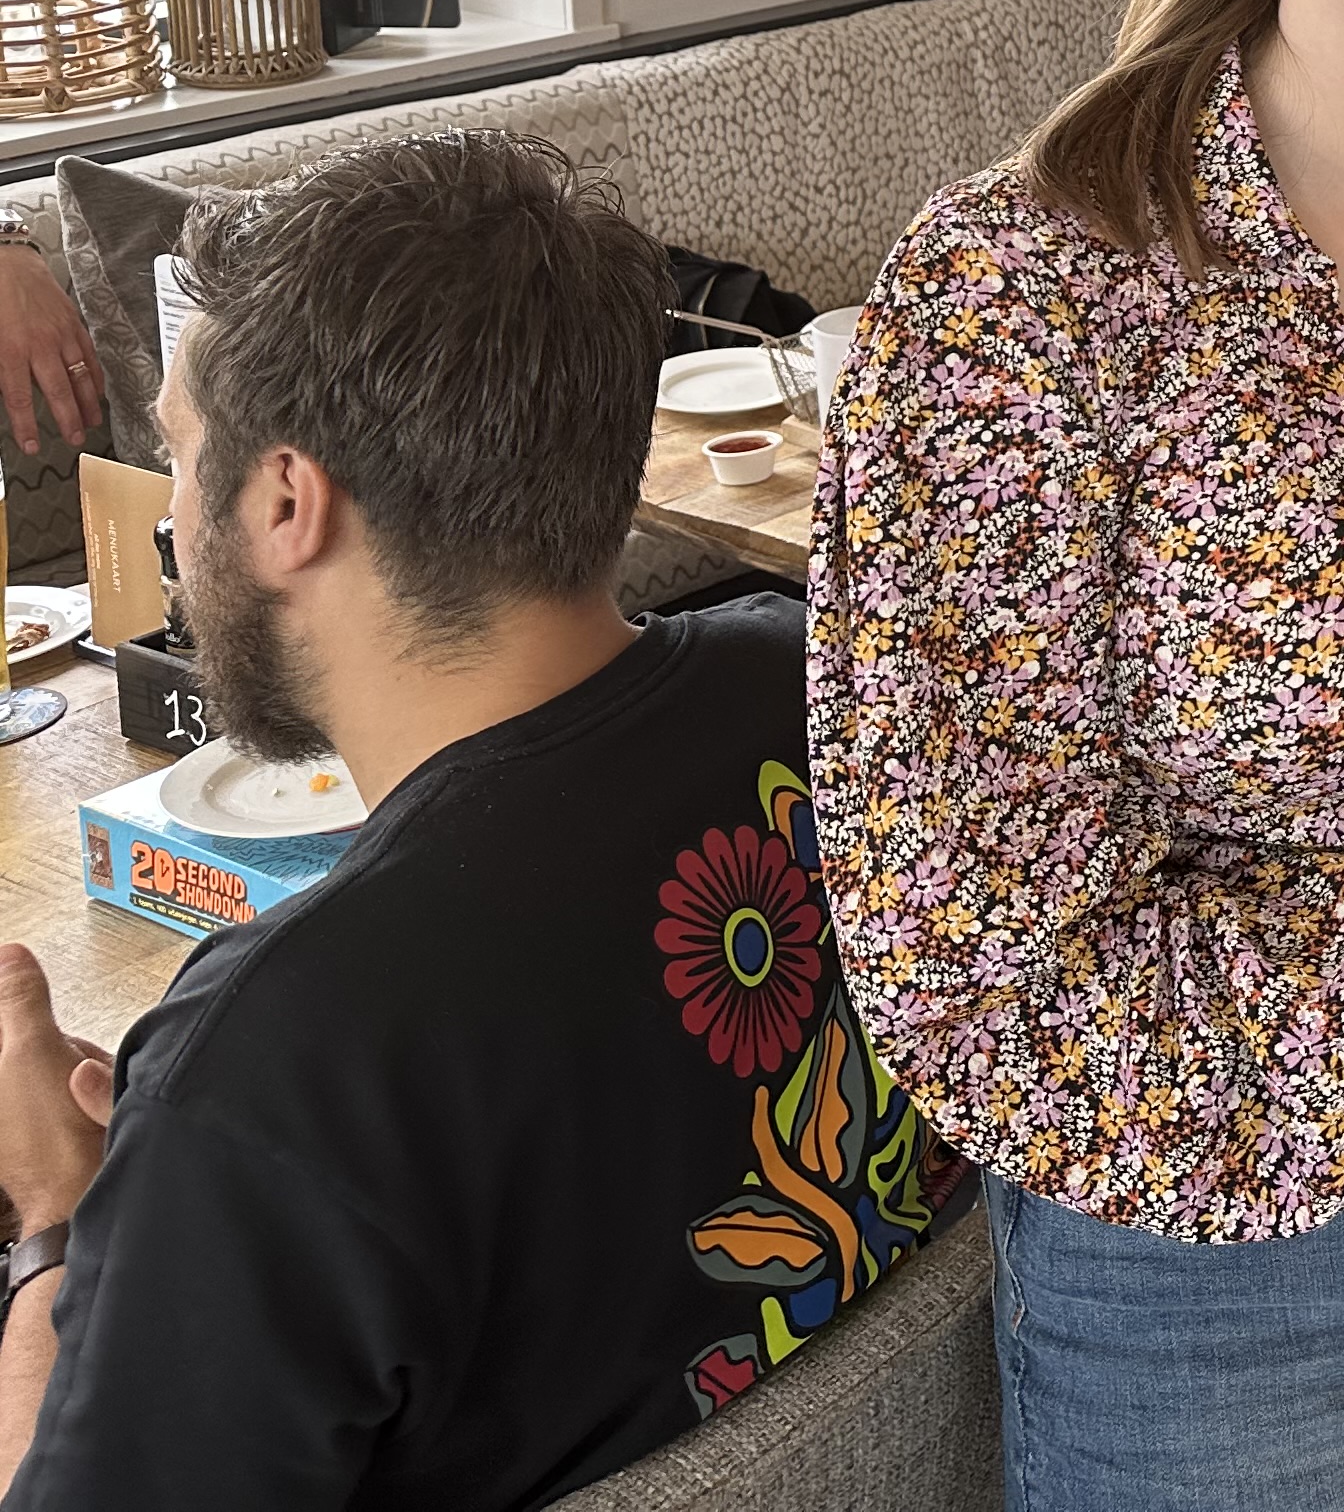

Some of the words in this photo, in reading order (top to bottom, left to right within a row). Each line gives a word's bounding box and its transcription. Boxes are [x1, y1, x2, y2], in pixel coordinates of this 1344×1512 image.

[108, 519, 121, 593] MENUKAART
[164, 689, 207, 747] 13
[130, 839, 176, 896] 20
[175, 857, 248, 900] SECOND
[175, 881, 257, 924] SHOWDOWN
